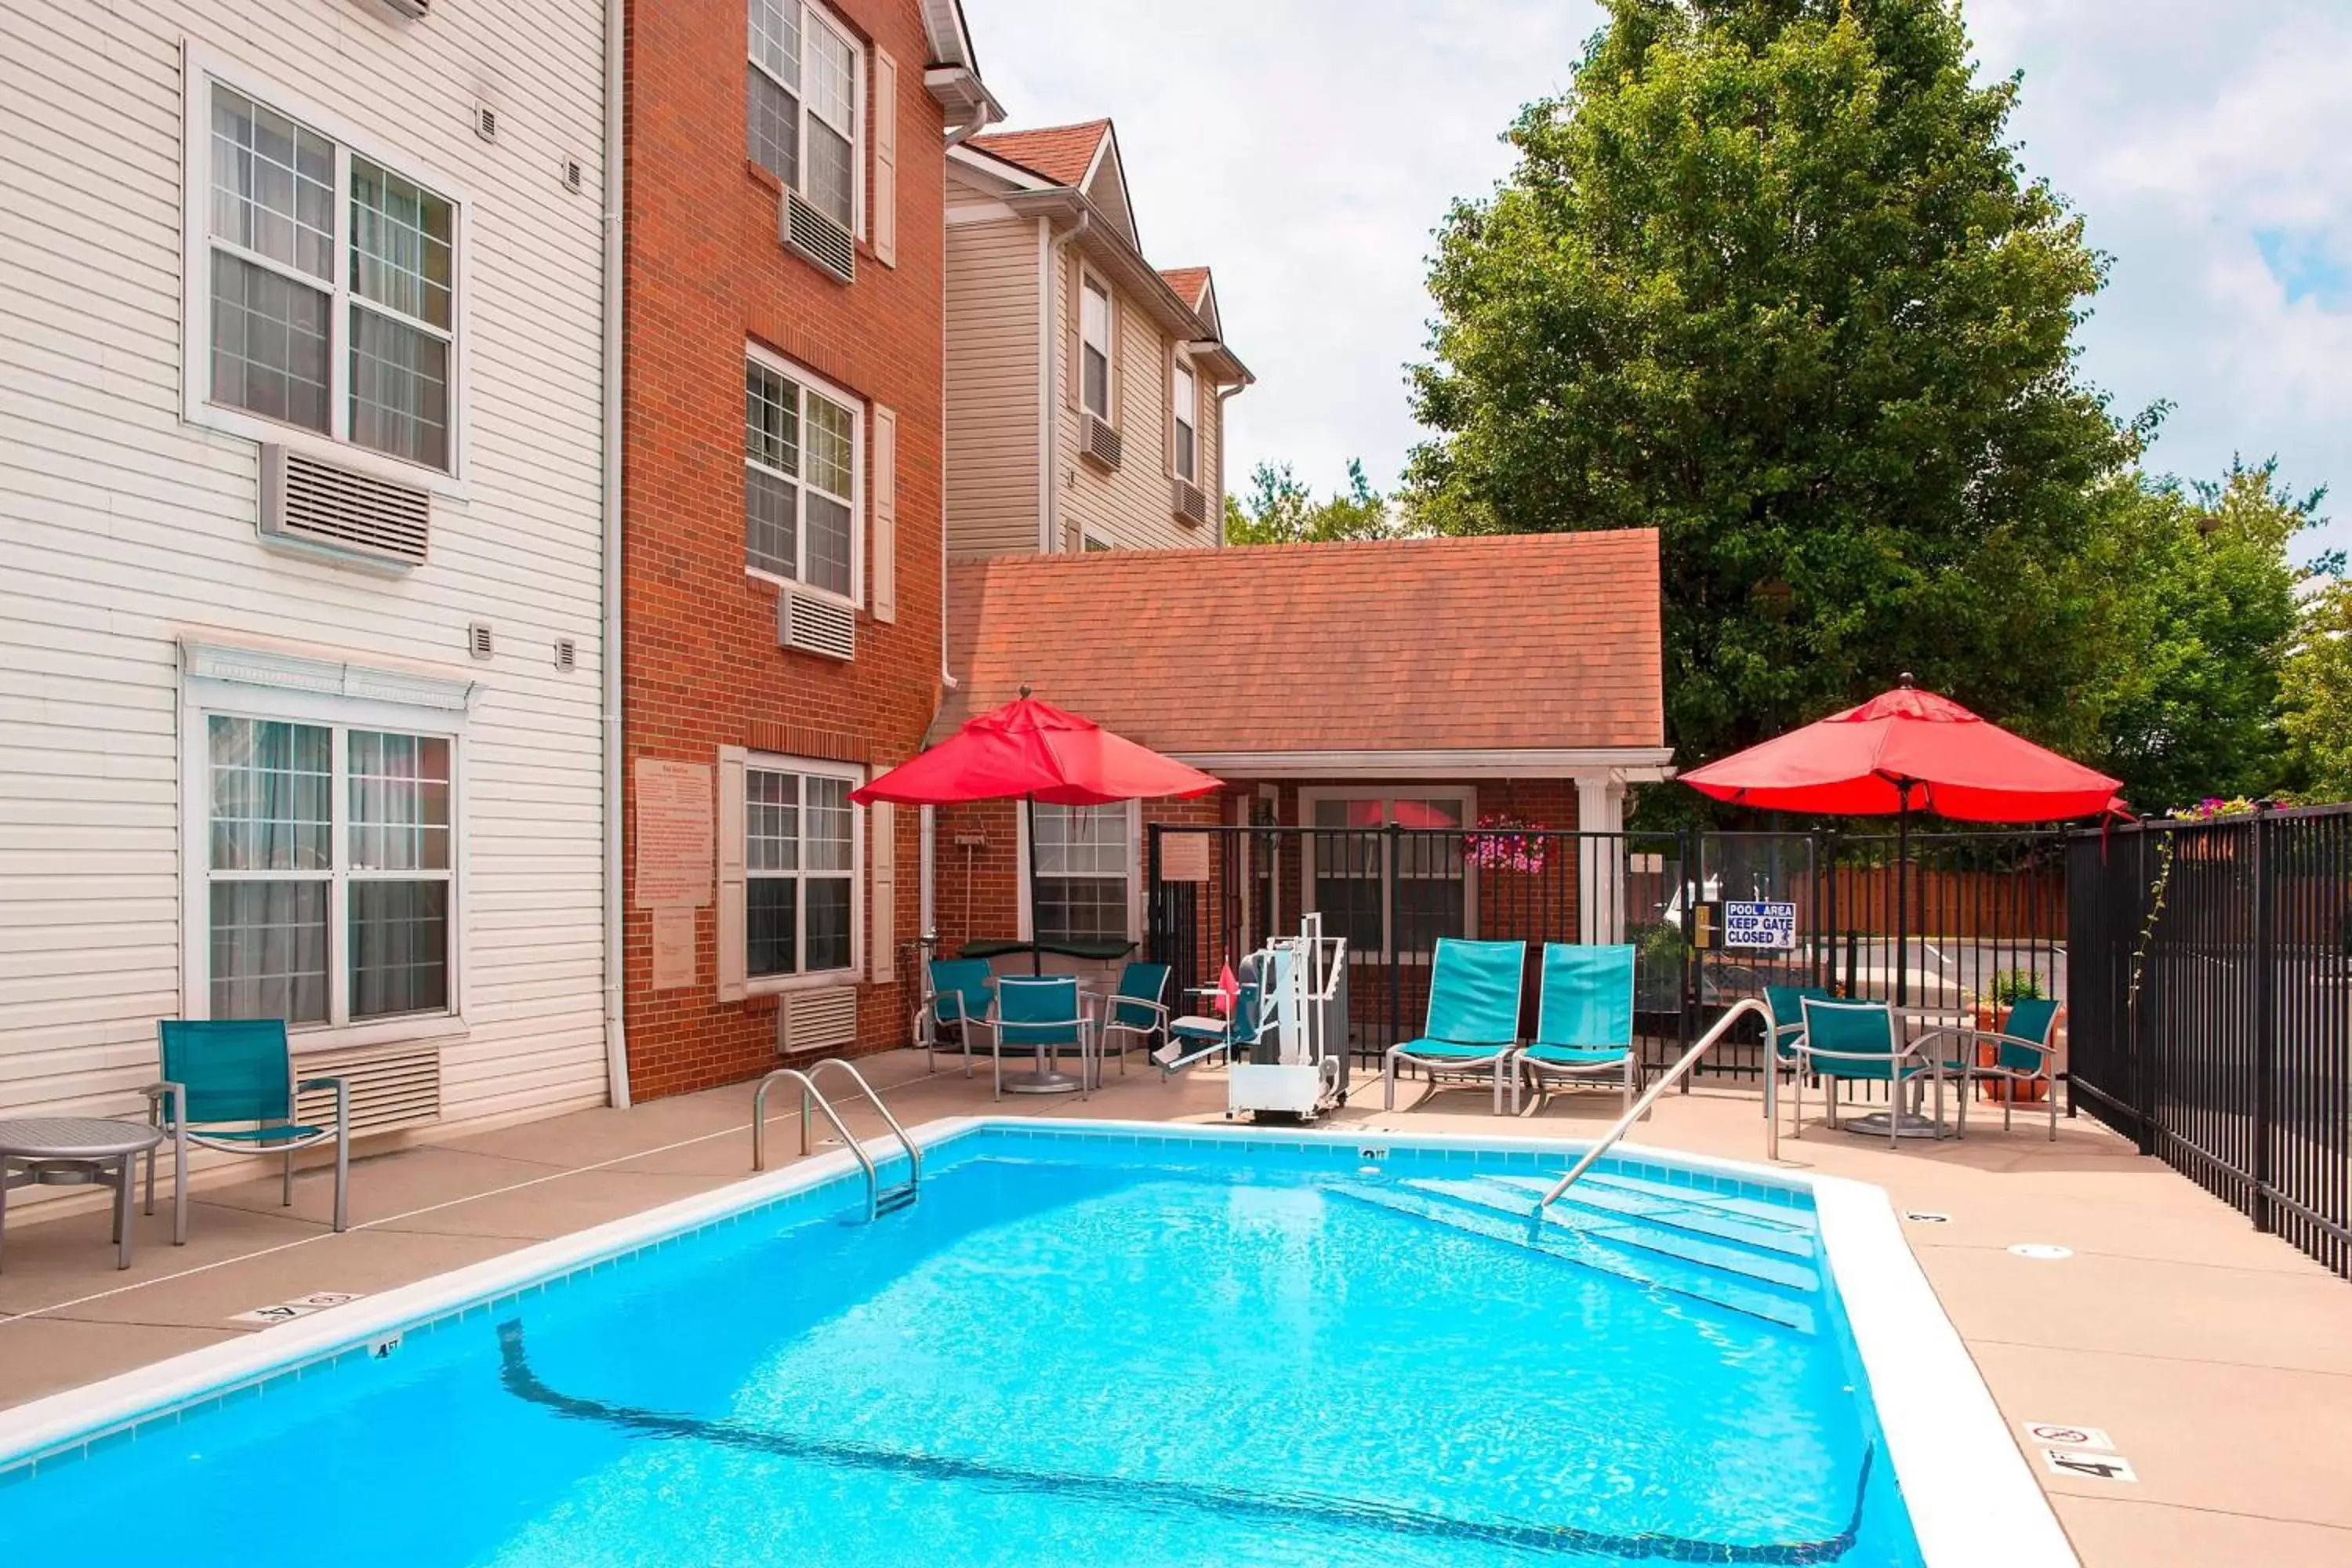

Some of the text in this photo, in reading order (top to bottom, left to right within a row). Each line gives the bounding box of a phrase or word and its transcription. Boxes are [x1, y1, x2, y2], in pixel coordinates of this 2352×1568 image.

[1730, 904, 1792, 916] POOL AREA
[1727, 917, 1793, 931] KEEP GATE
[1727, 931, 1774, 943] CLOSED
